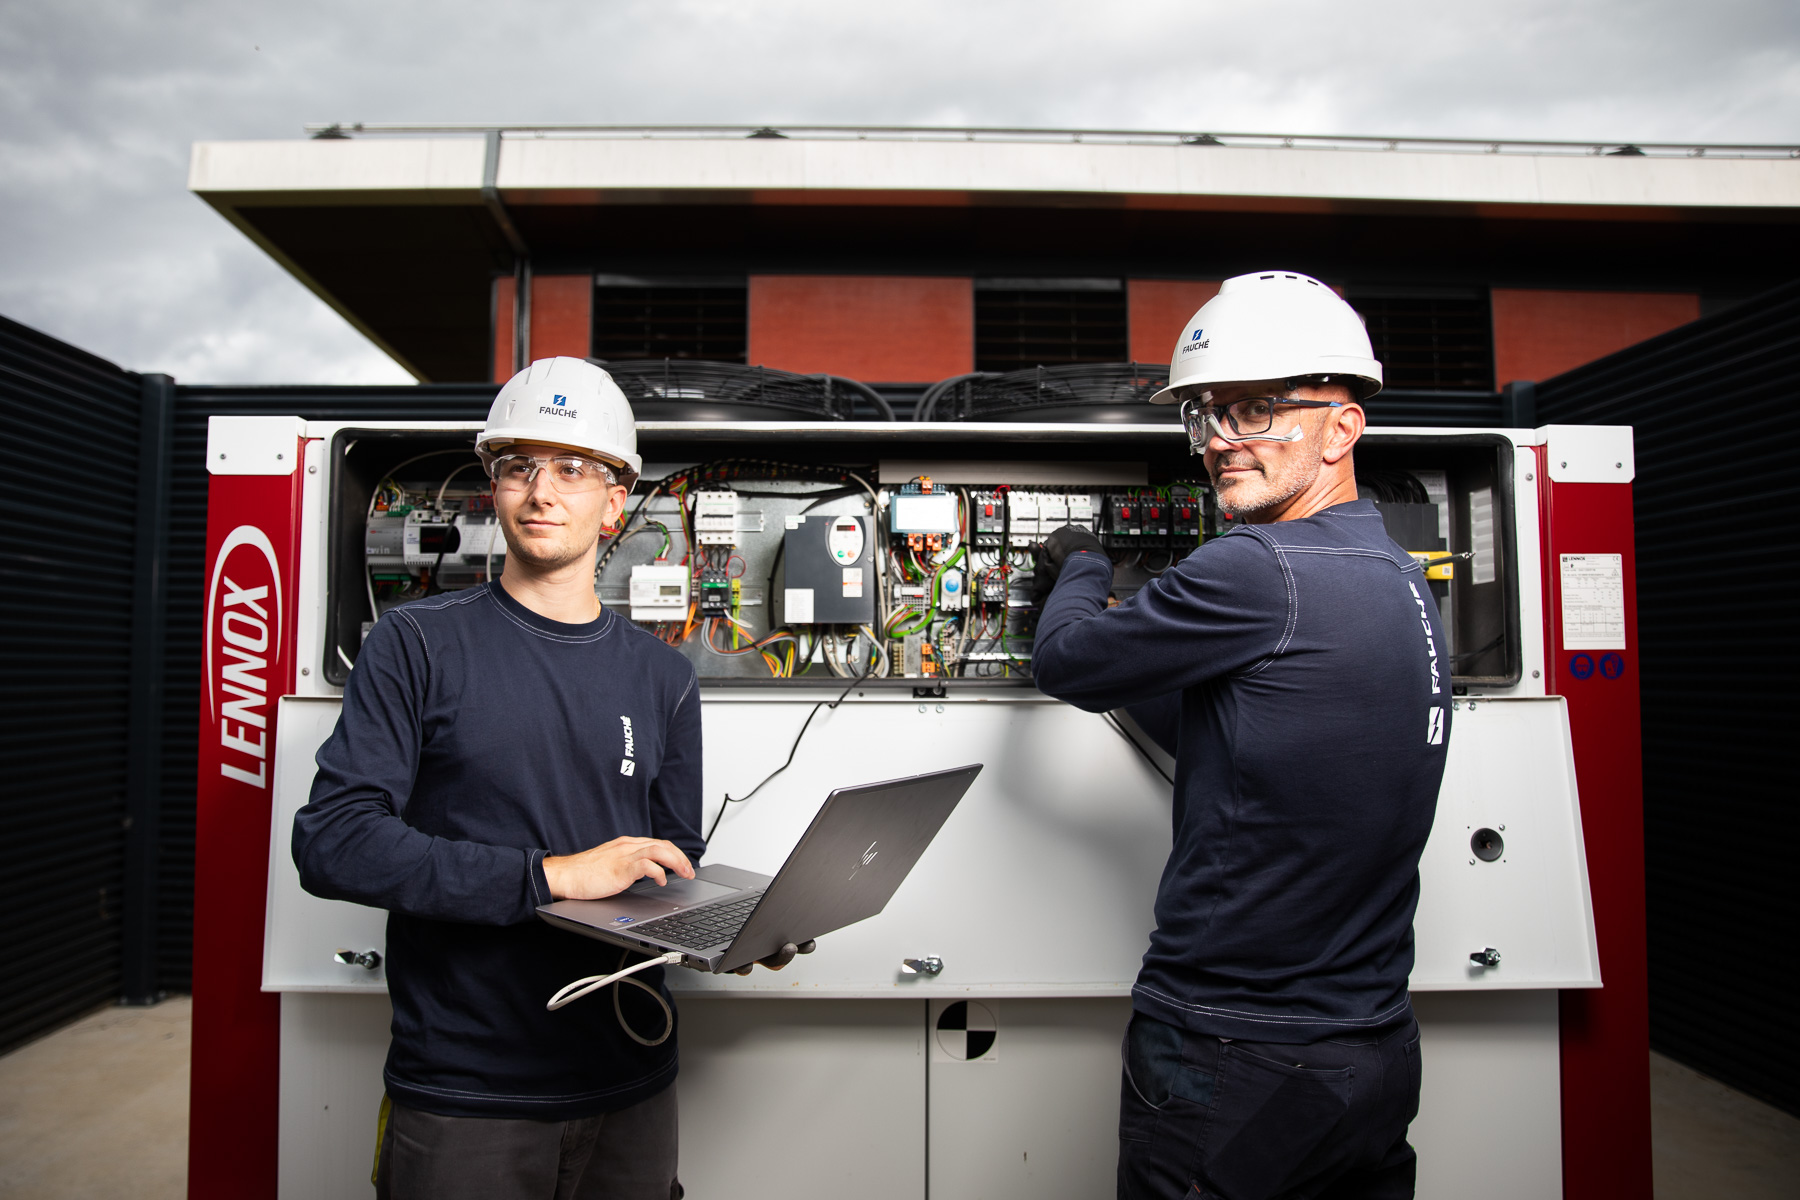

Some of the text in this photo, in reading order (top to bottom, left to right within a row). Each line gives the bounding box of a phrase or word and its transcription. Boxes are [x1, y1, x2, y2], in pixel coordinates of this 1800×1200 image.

[1182, 339, 1210, 354] FAUCHÉ
[539, 406, 578, 419] FAUCHÉ
[221, 576, 269, 790] LENNOX
[620, 715, 634, 757] FAUCHÉ
